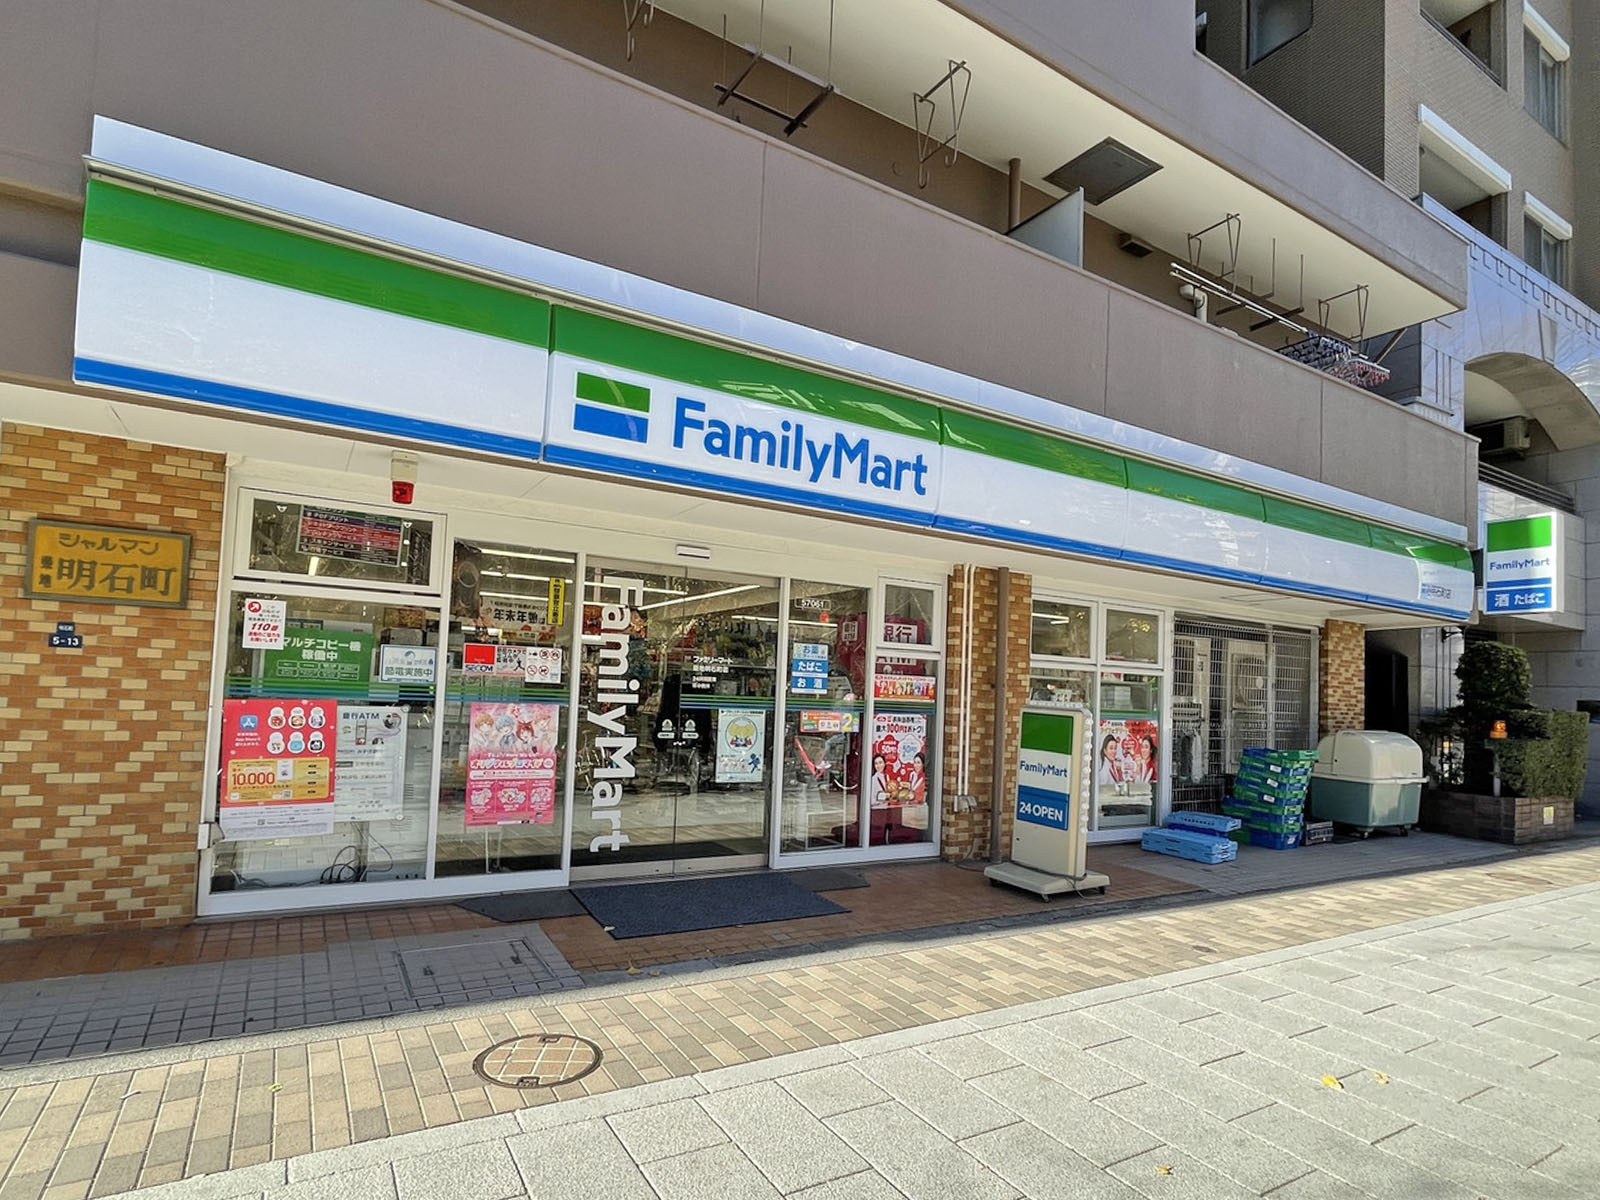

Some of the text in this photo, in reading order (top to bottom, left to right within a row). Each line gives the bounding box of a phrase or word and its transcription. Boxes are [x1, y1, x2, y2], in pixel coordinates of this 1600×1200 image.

[673, 396, 928, 496] FamilyMart
[58, 532, 159, 556] シャルマン
[1489, 557, 1550, 570] FamilyMart
[56, 557, 177, 597] 明石町
[1494, 592, 1546, 607] 酒 たばこ
[52, 636, 79, 646] 5-13
[465, 664, 493, 672] SECOM
[798, 661, 823, 672] たばこ
[587, 576, 644, 852] FamilyMart
[1019, 761, 1068, 778] FamilyMart
